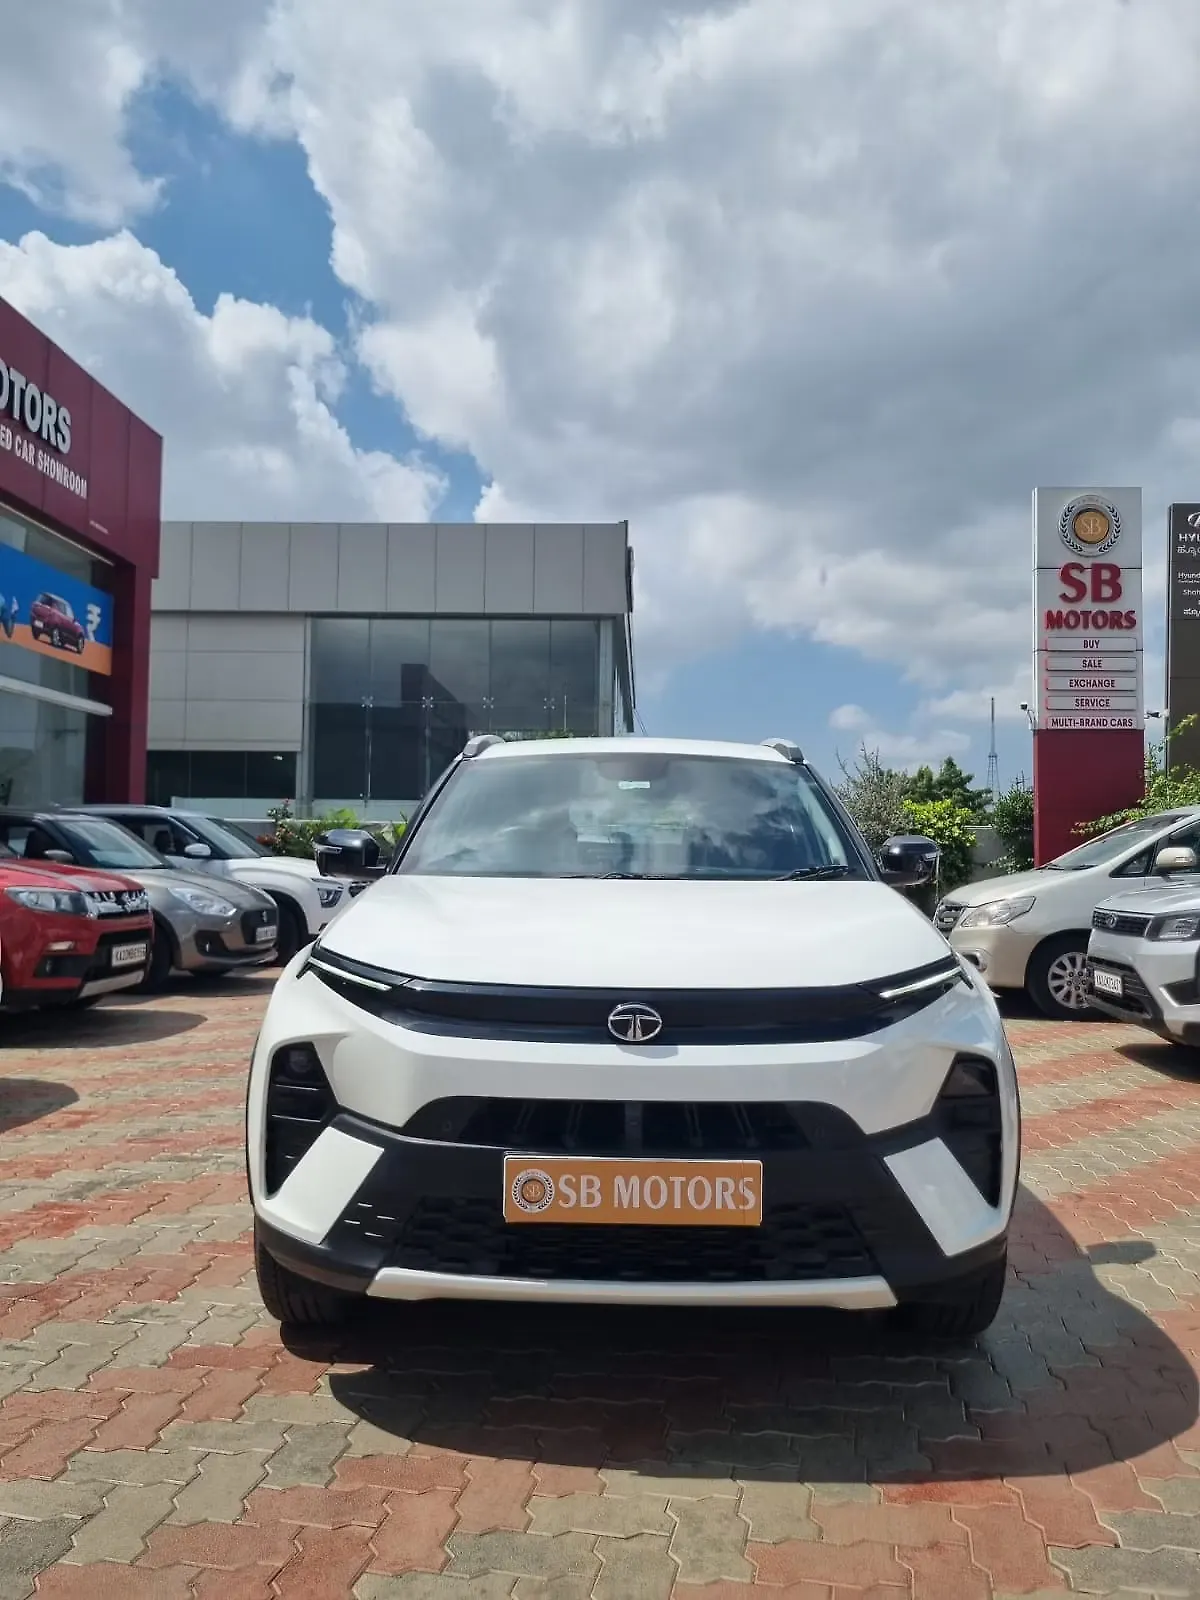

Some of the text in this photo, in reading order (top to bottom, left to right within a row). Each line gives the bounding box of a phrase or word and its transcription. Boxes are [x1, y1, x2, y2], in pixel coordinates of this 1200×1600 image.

[15, 435, 35, 466] CAR
[37, 449, 88, 499] SHOWROOM
[1059, 562, 1123, 604] SB
[1045, 609, 1137, 631] MOTORS
[1083, 639, 1100, 649] BUY
[1082, 659, 1103, 668] SALE
[1069, 679, 1116, 688] EXCHANGE
[1075, 698, 1111, 707] SERVICE
[1051, 718, 1133, 728] MULTI-BRAND CARS
[558, 1174, 757, 1210] SB MOTORS
